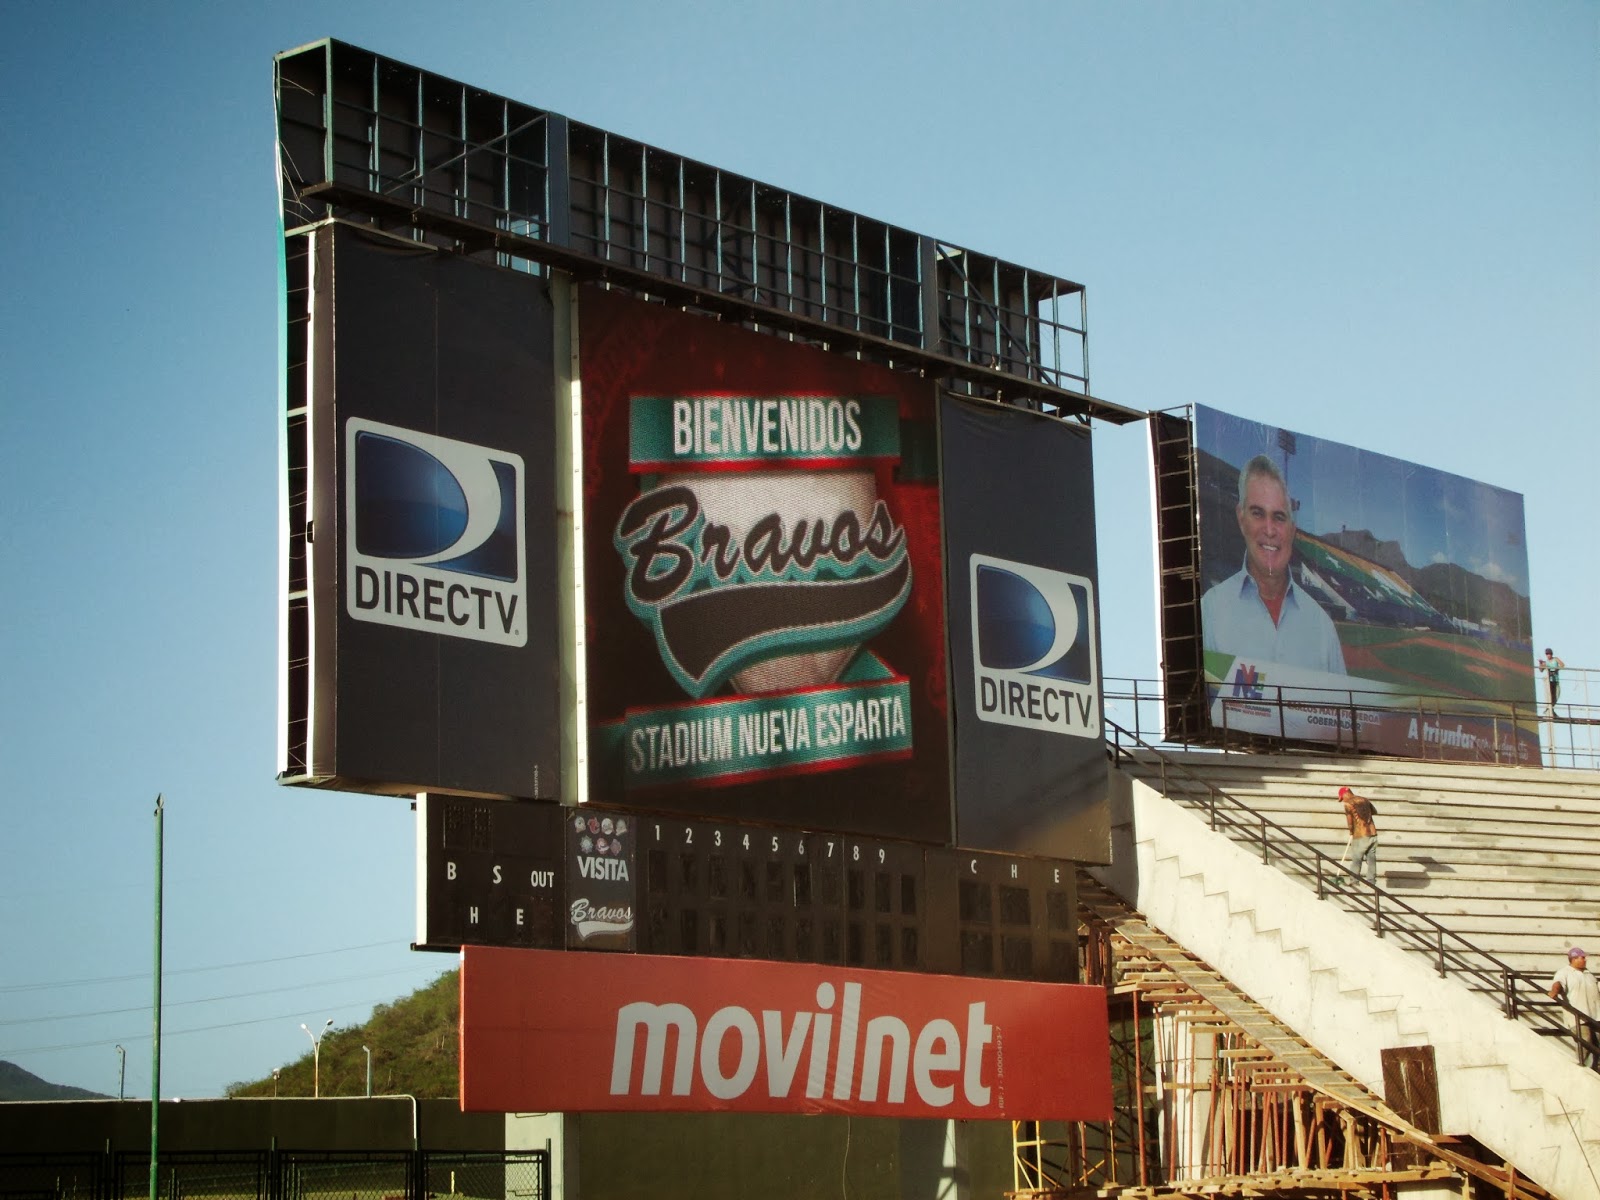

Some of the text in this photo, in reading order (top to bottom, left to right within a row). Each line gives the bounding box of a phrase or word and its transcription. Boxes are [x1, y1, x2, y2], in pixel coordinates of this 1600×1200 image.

[673, 399, 862, 455] BIENVENIDOS
[617, 485, 905, 604] Bravos
[355, 565, 519, 634] DIRECTV
[980, 676, 1093, 728] DIRECTV
[1341, 708, 1381, 724] FIGEROA
[631, 697, 906, 772] STADIUM NUEVA ESPARTA
[1307, 715, 1362, 732] GOBERNADR
[1407, 718, 1418, 740] A
[577, 855, 630, 882] VISITA
[655, 825, 1060, 883] 1 2 3 4 5 6 7 8 9 C H E
[447, 861, 555, 888] B S OUT
[470, 906, 524, 925] H E
[571, 898, 633, 925] Bravos
[610, 981, 993, 1107] movilnet
